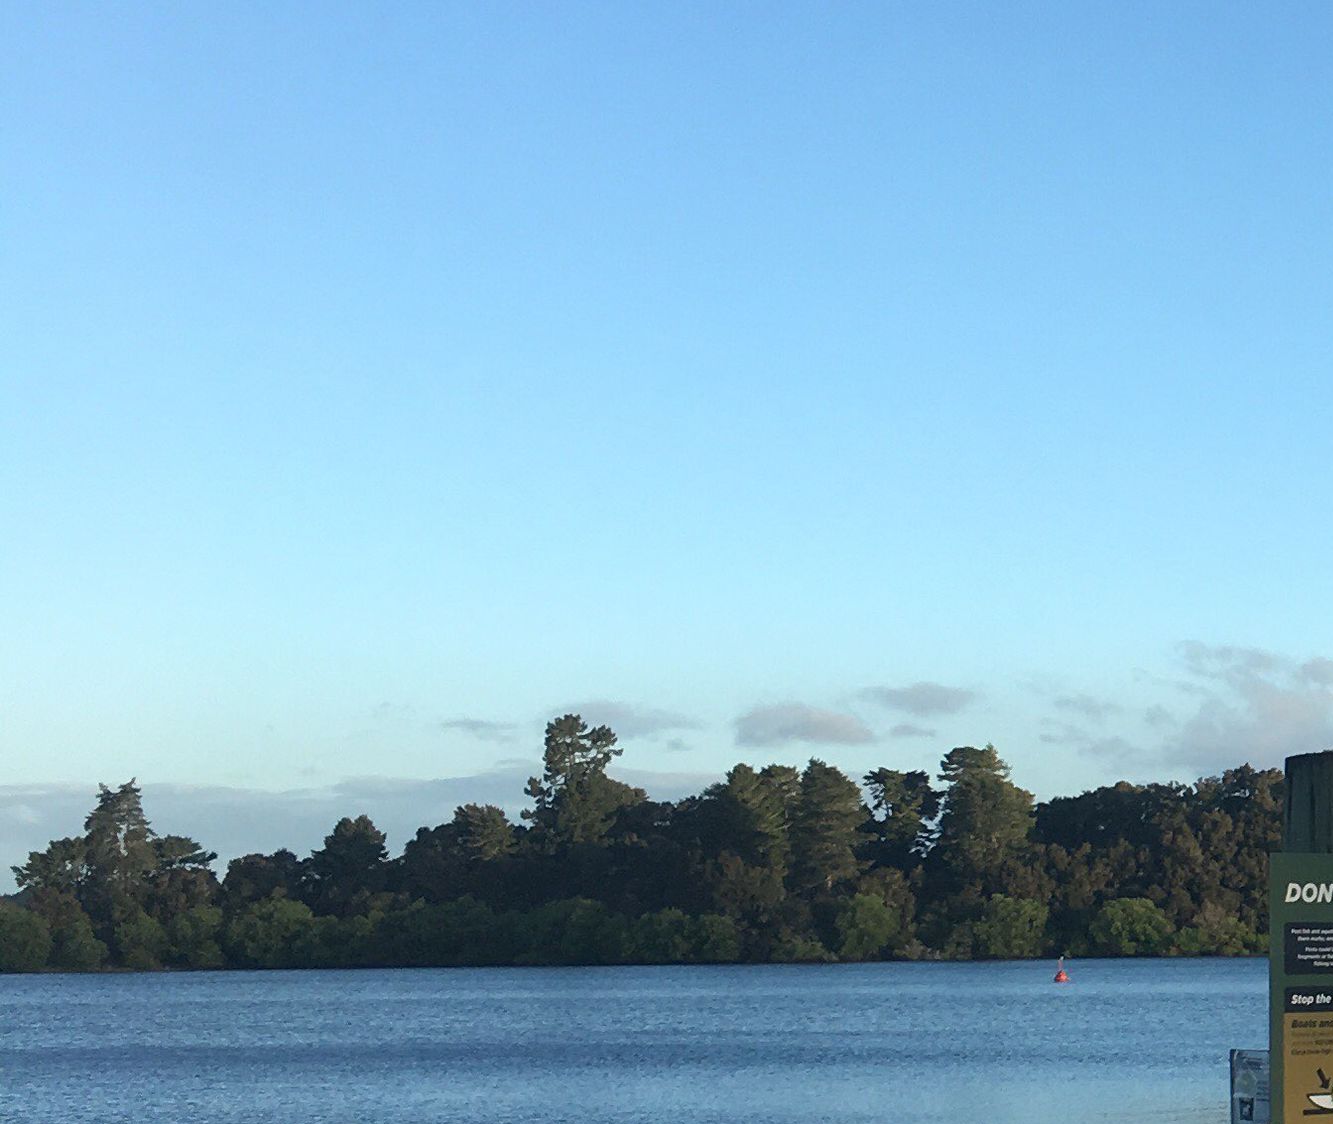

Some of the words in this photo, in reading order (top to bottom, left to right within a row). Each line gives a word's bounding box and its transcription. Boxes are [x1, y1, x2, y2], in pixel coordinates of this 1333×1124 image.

[1291, 994, 1315, 1006] Stop
[1316, 994, 1331, 1004] the
[1291, 1018, 1317, 1029] Boats
